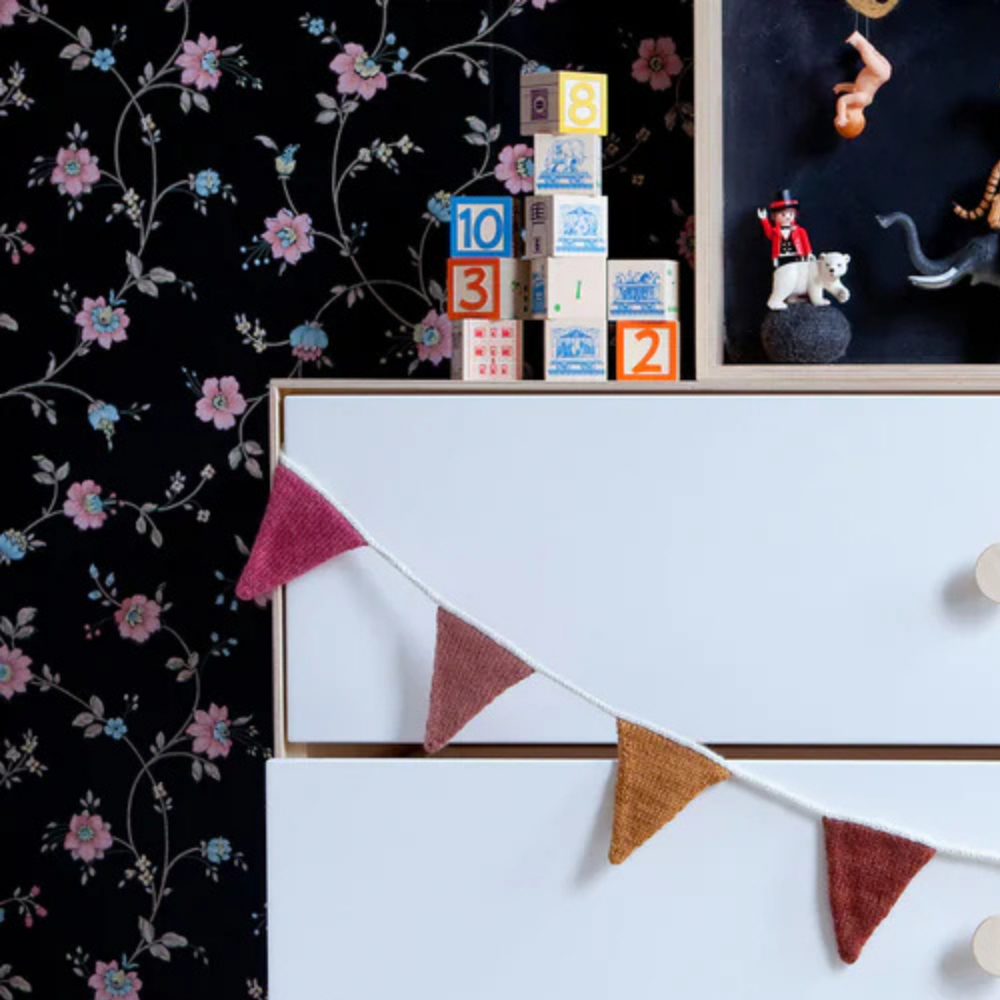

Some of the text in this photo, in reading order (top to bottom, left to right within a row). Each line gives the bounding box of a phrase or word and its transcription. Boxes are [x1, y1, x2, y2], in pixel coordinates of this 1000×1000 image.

[568, 81, 597, 125] 8
[459, 207, 502, 249] 10
[459, 267, 489, 310] 3
[631, 328, 662, 374] 2
